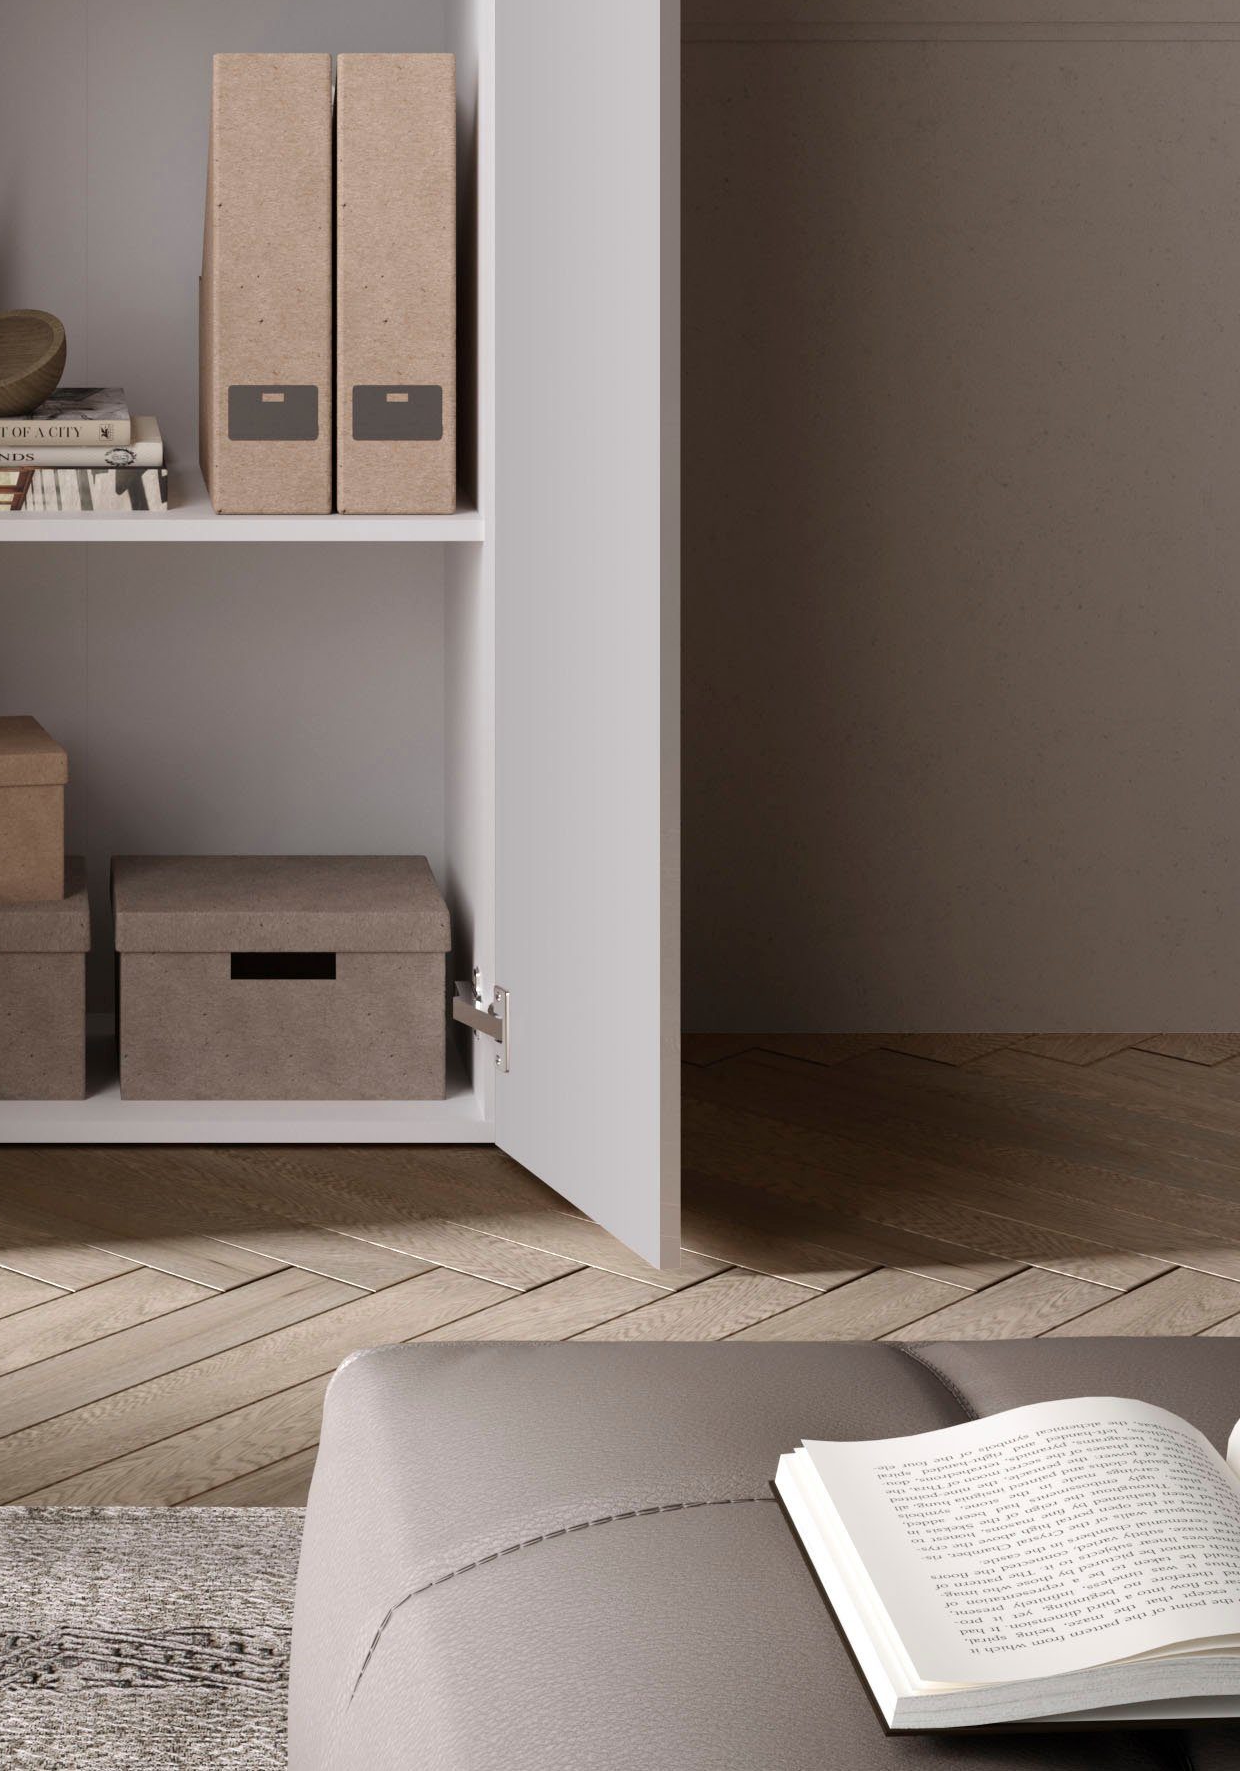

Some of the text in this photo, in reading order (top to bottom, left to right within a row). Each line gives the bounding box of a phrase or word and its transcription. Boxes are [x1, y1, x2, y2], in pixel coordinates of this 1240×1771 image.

[12, 426, 31, 438] OF
[34, 426, 46, 438] A
[48, 426, 83, 438] CITY
[1035, 1422, 1101, 1437] alchemical
[877, 1451, 1003, 1480] right-handed spiral
[1008, 1471, 1057, 1491] painted
[1061, 1473, 1096, 1484] made
[889, 1487, 971, 1504] nine-pointed
[1029, 1478, 1118, 1503] embossments
[1024, 1483, 1170, 1514] Throughout reign
[1091, 1492, 1157, 1506] fashioned
[898, 1508, 951, 1519] symbols
[1041, 1508, 1066, 1519] fine
[1112, 1511, 1148, 1520] walls
[978, 1503, 1132, 1544] open portal high above
[1069, 1521, 1090, 1531] the
[930, 1532, 976, 1542] honest
[1016, 1529, 1064, 1547] Crystal
[1067, 1524, 1131, 1544] chambers
[1123, 1529, 1164, 1539] subtly
[1137, 1537, 1178, 1546] linear
[1024, 1546, 1047, 1555] the
[1078, 1542, 1133, 1561] subjects
[1159, 1544, 1205, 1553] cannot
[1000, 1550, 1069, 1572] connected
[1078, 1551, 1135, 1573] pictured
[1134, 1556, 1172, 1566] taken
[930, 1572, 969, 1580] floors
[1008, 1570, 1036, 1580] The
[1016, 1574, 1053, 1587] those
[1151, 1571, 1214, 1583] therefore
[953, 1575, 1003, 1588] pattern
[1170, 1581, 1200, 1590] flow
[966, 1582, 1065, 1605] representation
[982, 1585, 1012, 1595] who
[1137, 1586, 1166, 1596] into
[1182, 1589, 1227, 1599] except
[1013, 1590, 1075, 1609] infinitely
[1145, 1595, 1174, 1605] that
[1169, 1599, 1207, 1610] point
[1086, 1598, 1121, 1613] third
[1113, 1604, 1136, 1614] the
[1012, 1609, 1033, 1619] yet
[1125, 1612, 1147, 1622] the
[959, 1628, 986, 1636] had
[1015, 1627, 1056, 1638] being
[1069, 1618, 1120, 1638] pattern
[1031, 1635, 1065, 1646] from
[984, 1643, 1027, 1654] which
